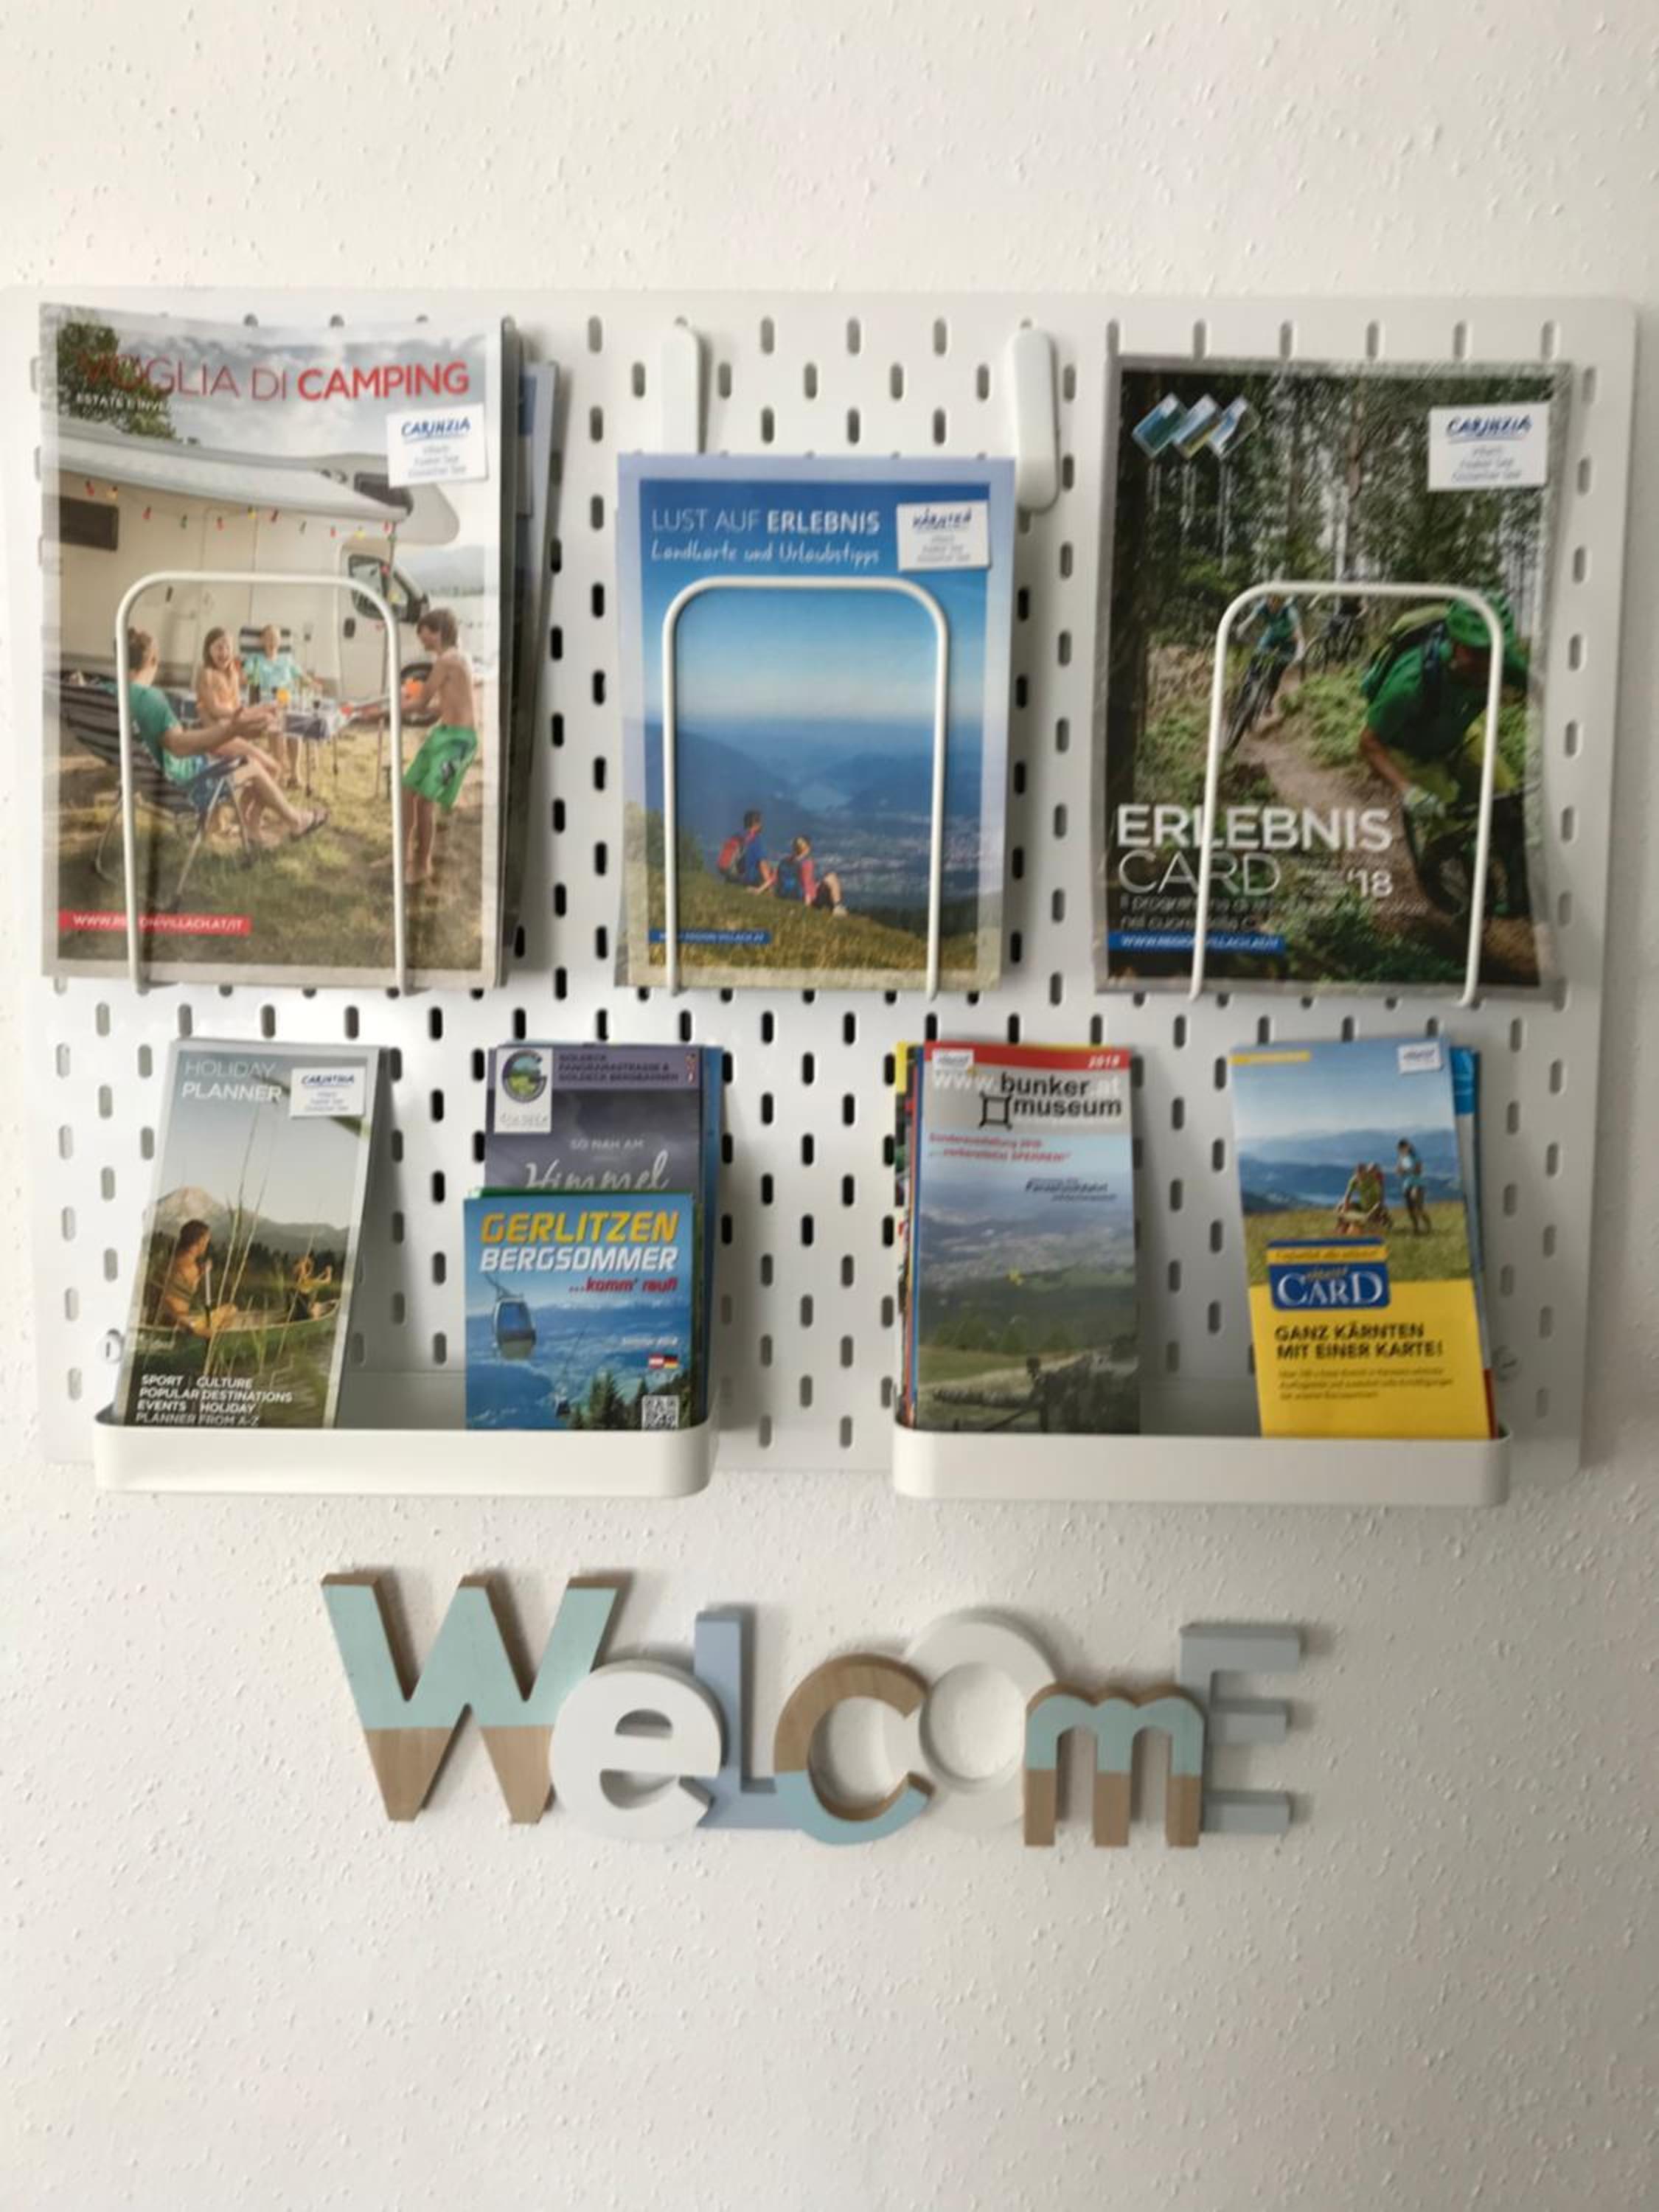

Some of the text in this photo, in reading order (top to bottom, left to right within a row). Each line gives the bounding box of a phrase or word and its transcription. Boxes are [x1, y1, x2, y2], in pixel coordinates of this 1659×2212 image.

[81, 352, 470, 402] VOGLIA DI CAMPING
[651, 509, 880, 535] LUST AUF ERLEBNIS
[651, 539, 880, 569] Landkarte und Urlaubstipps
[1116, 804, 1394, 853] ERLEBNIS
[1118, 849, 1281, 895] CARD
[185, 1059, 277, 1077] HOLIDAY
[182, 1082, 282, 1102] PLANNER
[1013, 1097, 1122, 1117] museum
[524, 1149, 670, 1190] Himmel
[481, 1210, 680, 1244] GERLITZEN
[479, 1246, 680, 1272] BERGSOMMER
[1277, 1270, 1383, 1307] CARD
[1274, 1321, 1425, 1343] GANZ KÄRNTEN
[1276, 1343, 1309, 1361] MIT
[1315, 1341, 1371, 1360] EINER
[142, 1374, 252, 1388] SPORT CULTURE
[136, 1399, 256, 1413] EVENTS HOLIDAY
[139, 1388, 293, 1402] POPULAR DESTINATIONS
